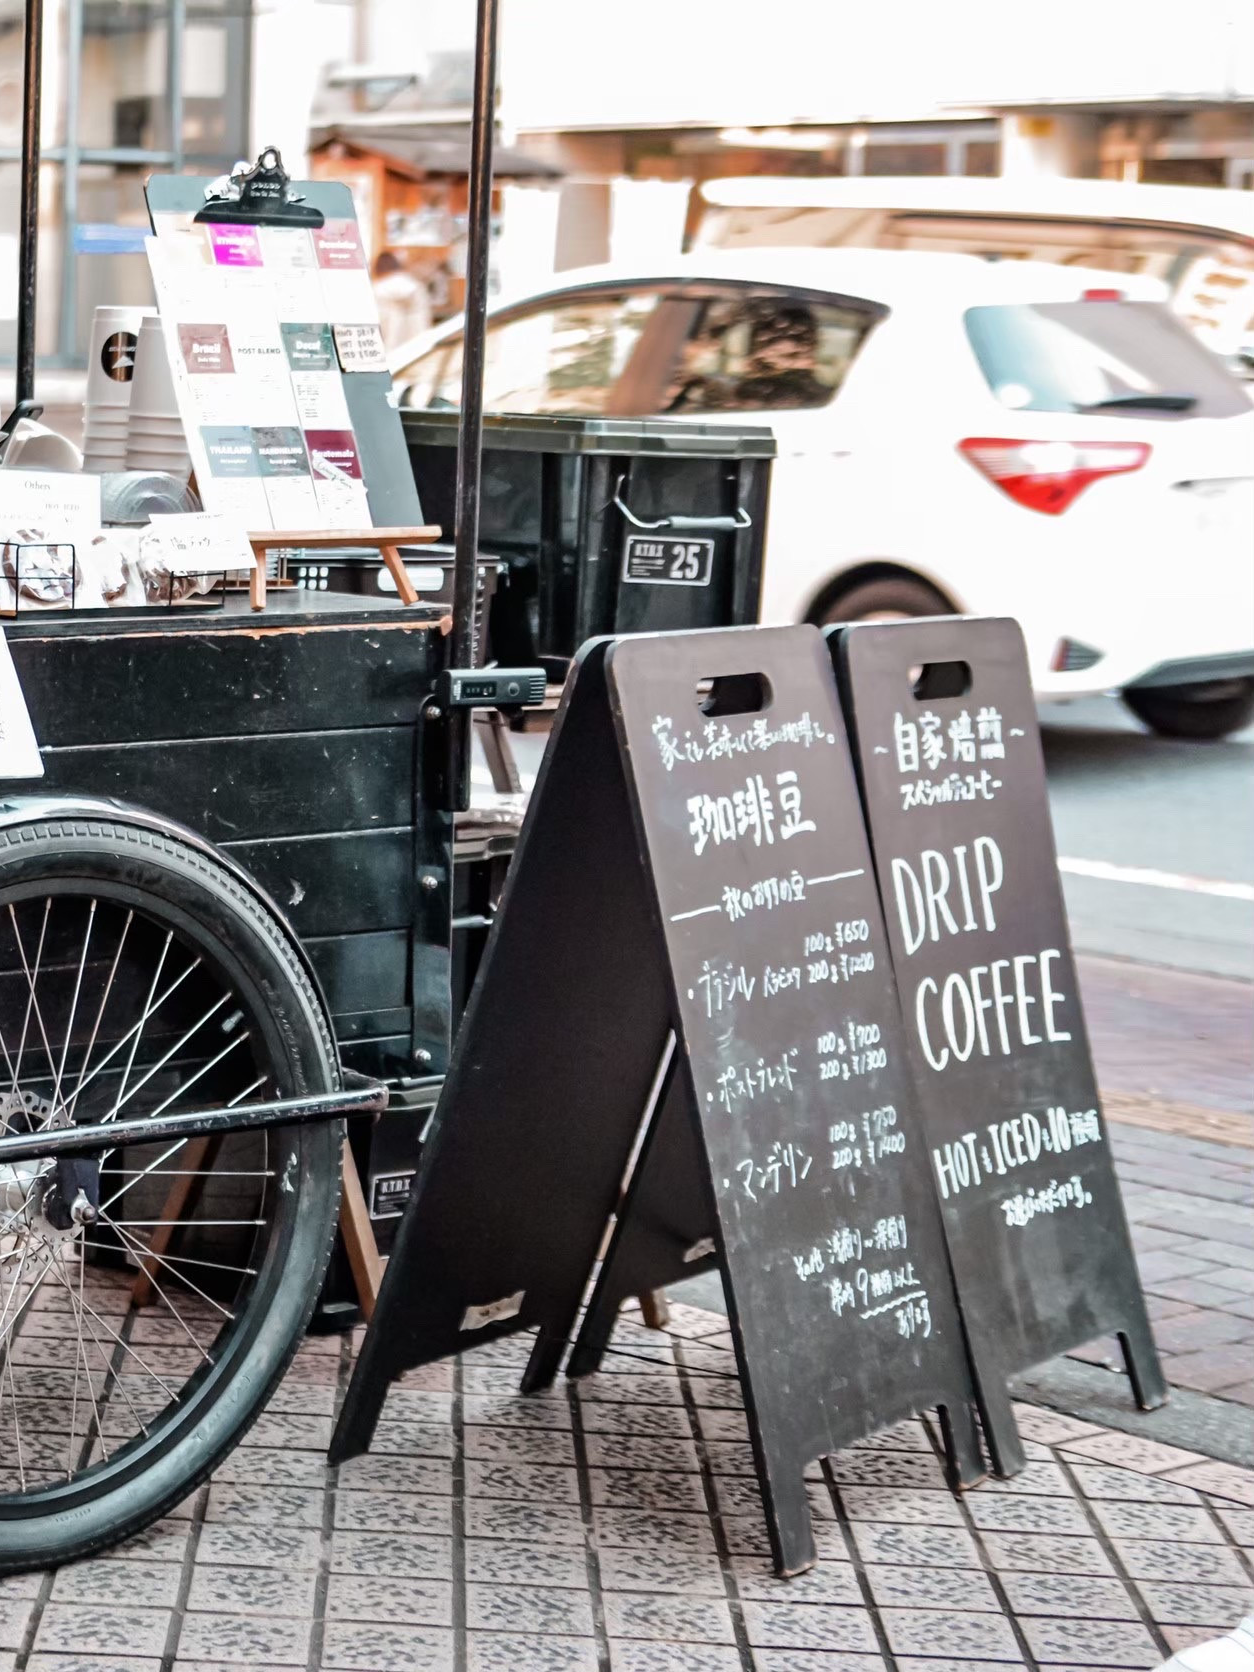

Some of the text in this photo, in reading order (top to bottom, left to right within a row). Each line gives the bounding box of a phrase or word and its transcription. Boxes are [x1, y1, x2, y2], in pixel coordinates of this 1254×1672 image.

[192, 343, 221, 354] Brazil
[238, 347, 281, 355] POST BLEND
[209, 446, 252, 455] THAILAND
[312, 450, 355, 458] Guatemala
[24, 480, 51, 491] Others
[669, 544, 701, 579] 25
[686, 771, 817, 856] 珈琲豆
[891, 835, 1004, 955] DRIP
[916, 949, 1072, 1071] COFFEE
